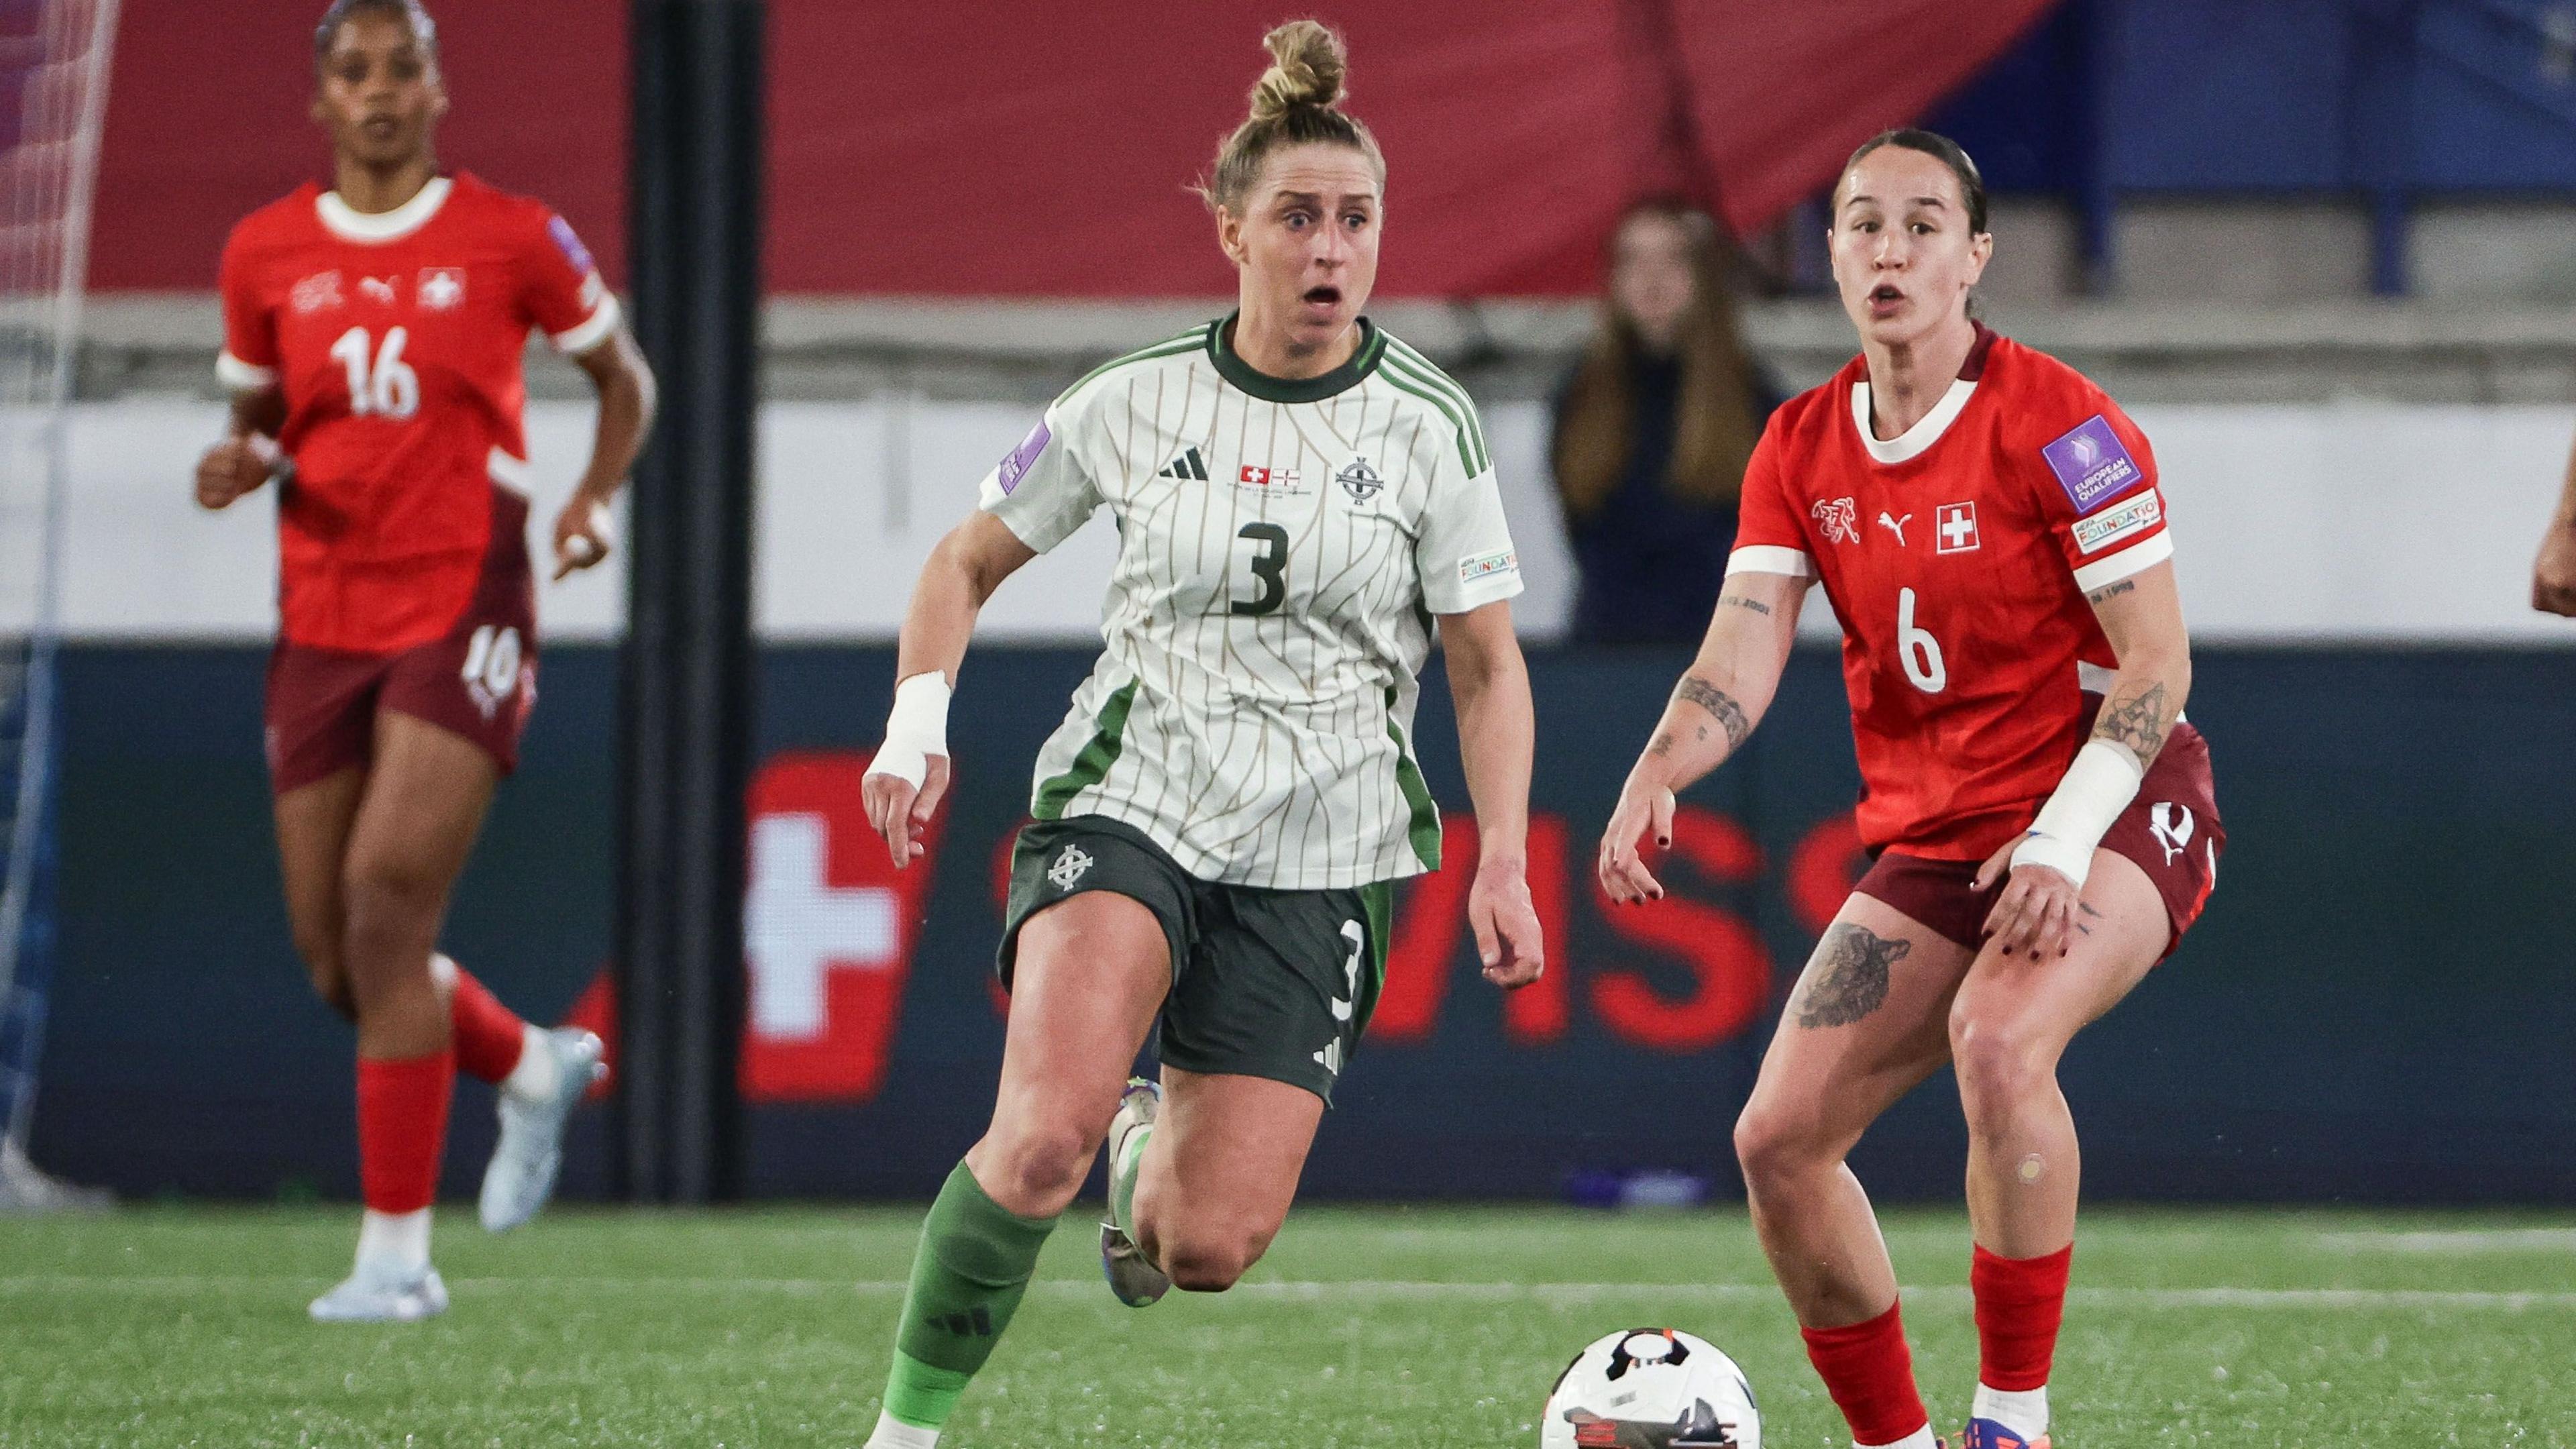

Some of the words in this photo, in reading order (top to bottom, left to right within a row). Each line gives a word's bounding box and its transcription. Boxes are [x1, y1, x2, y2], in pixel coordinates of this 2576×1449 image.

[331, 325, 419, 419] 16
[2074, 457, 2126, 493] EUROPEAN
[2078, 464, 2132, 502] QUALIFIERS
[2079, 500, 2157, 543] FOUNDATIO
[1230, 522, 1290, 615] 3
[1897, 586, 1947, 694] 6
[1332, 918, 1364, 1021] 3
